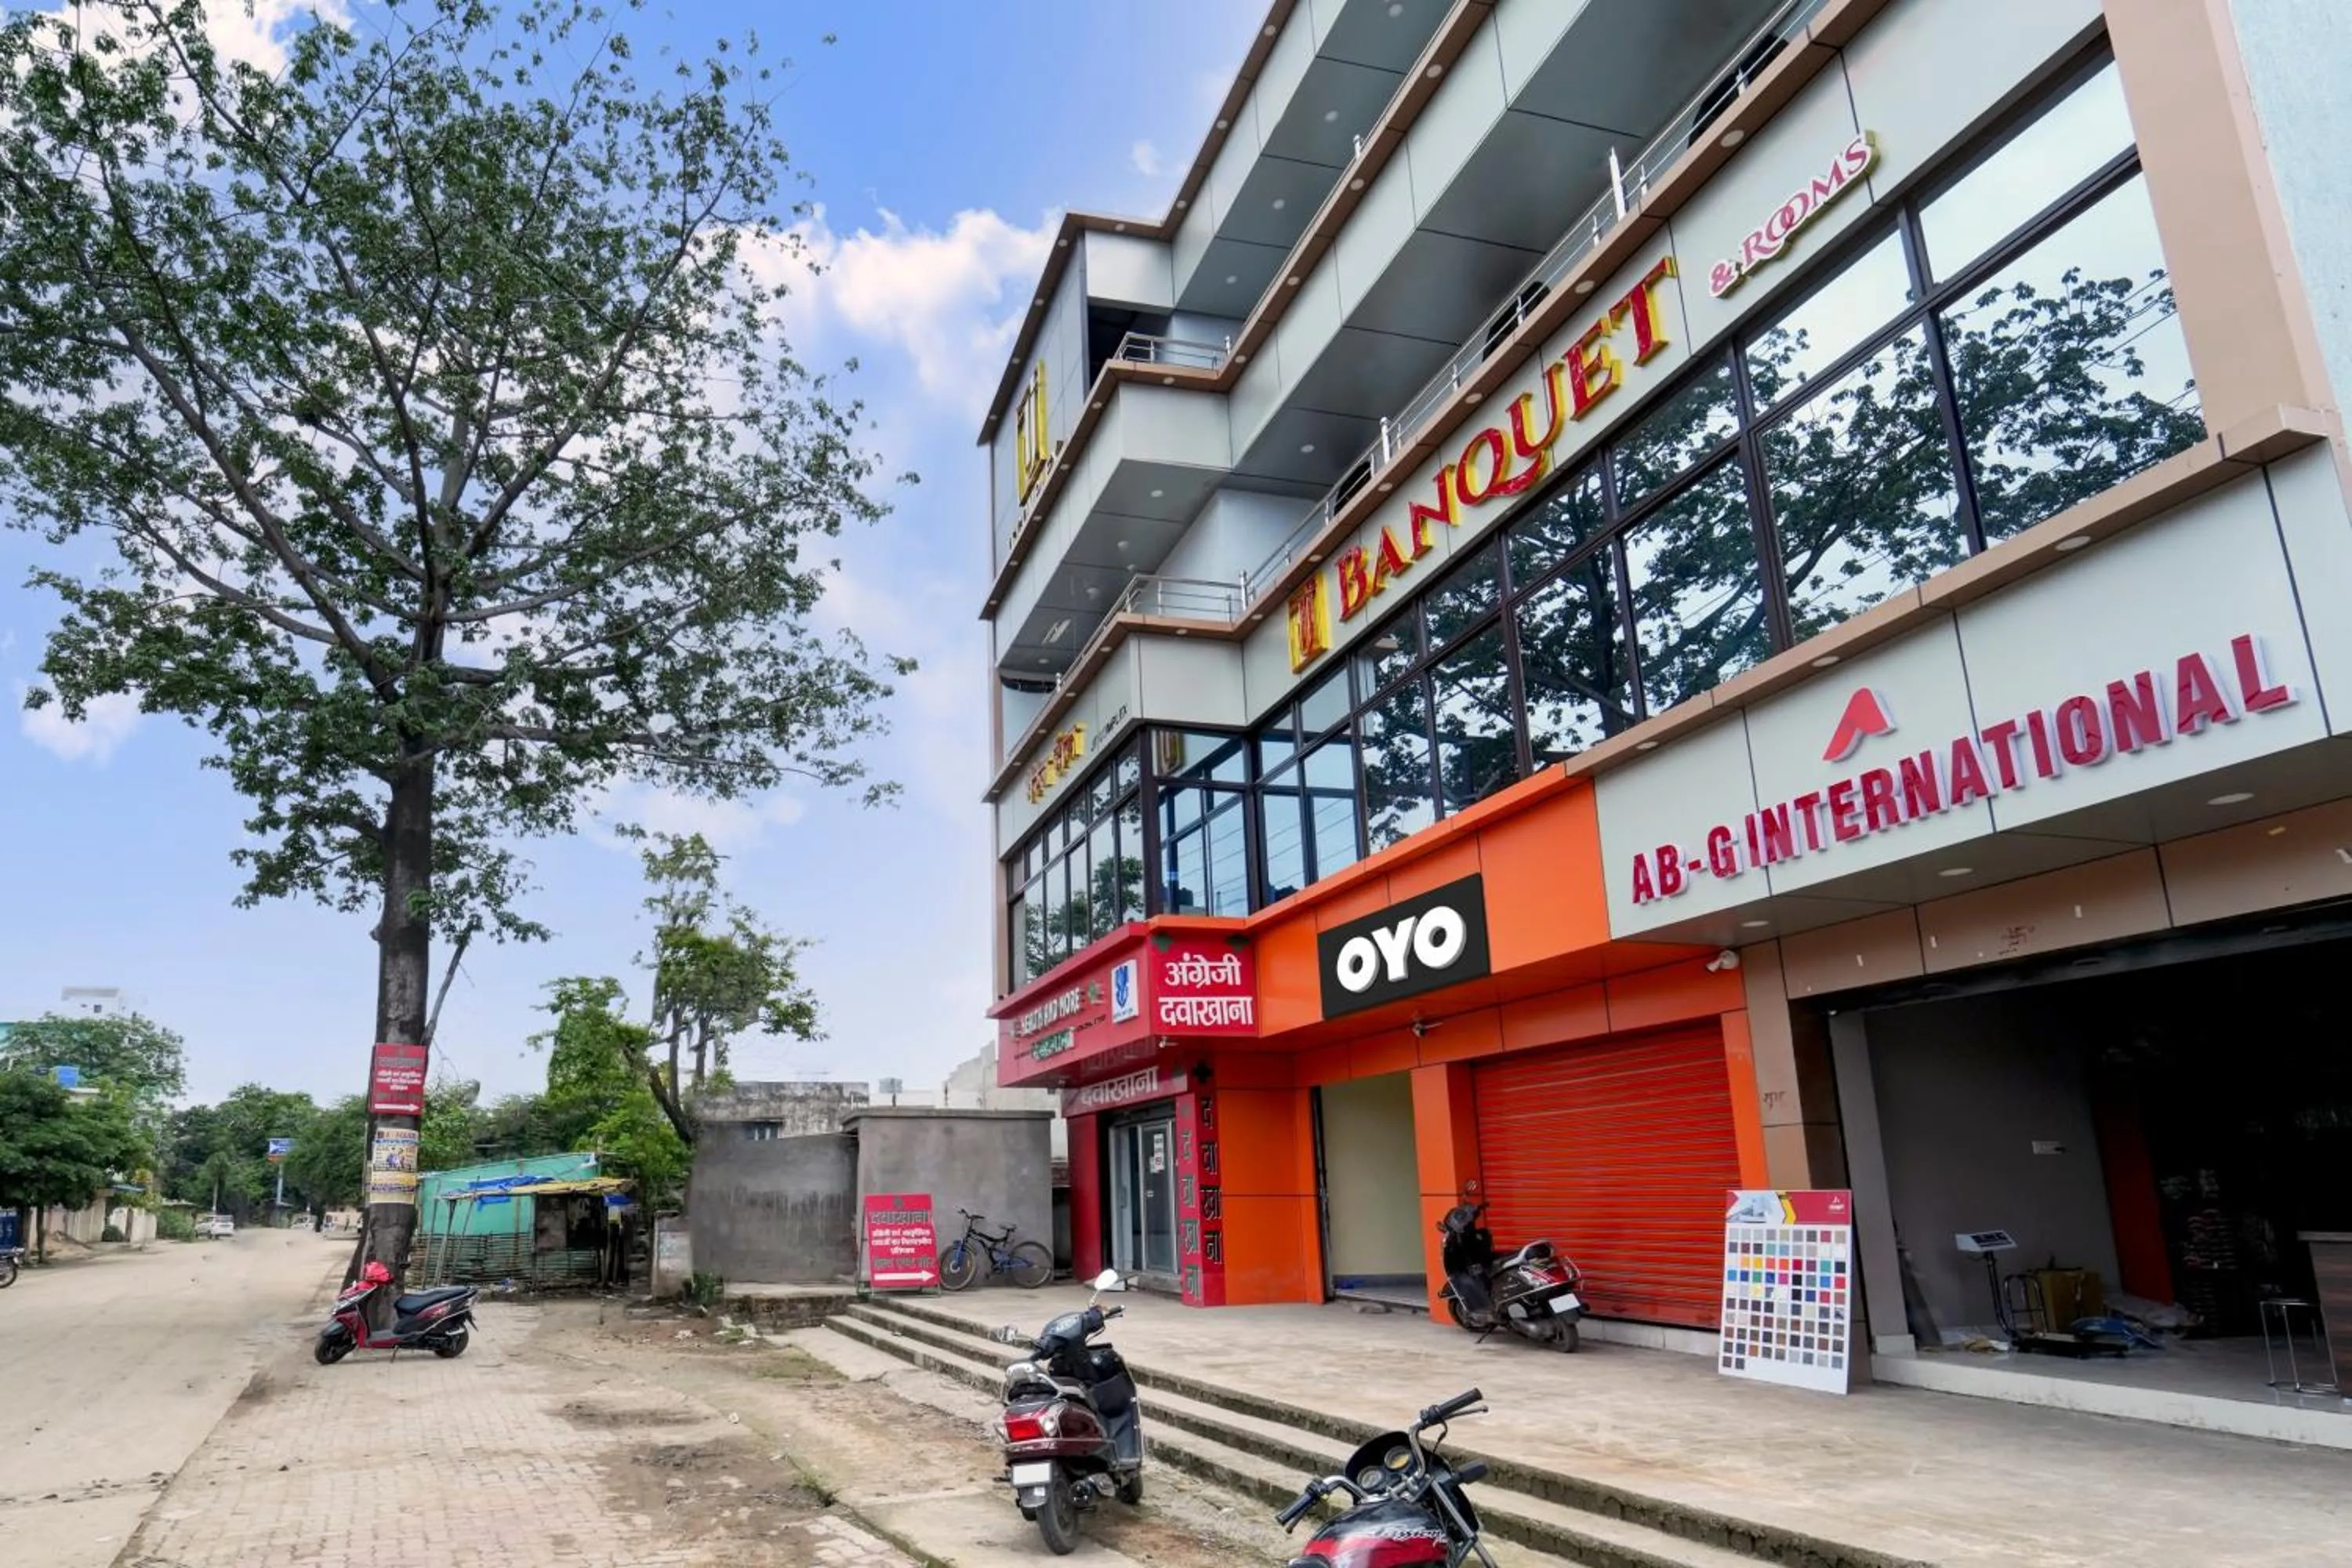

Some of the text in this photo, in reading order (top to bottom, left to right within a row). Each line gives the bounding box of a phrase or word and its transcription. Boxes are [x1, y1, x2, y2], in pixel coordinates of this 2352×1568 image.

[1741, 131, 1878, 274] ROOMS
[1335, 256, 1677, 622] BANQUET
[1744, 633, 2299, 868] INTERNATIONAL
[1165, 952, 1242, 989] अंग्रेजी
[1337, 906, 1467, 993] OYO
[1157, 996, 1254, 1026] दवाखाना
[1080, 1065, 1159, 1106] दवाखाना
